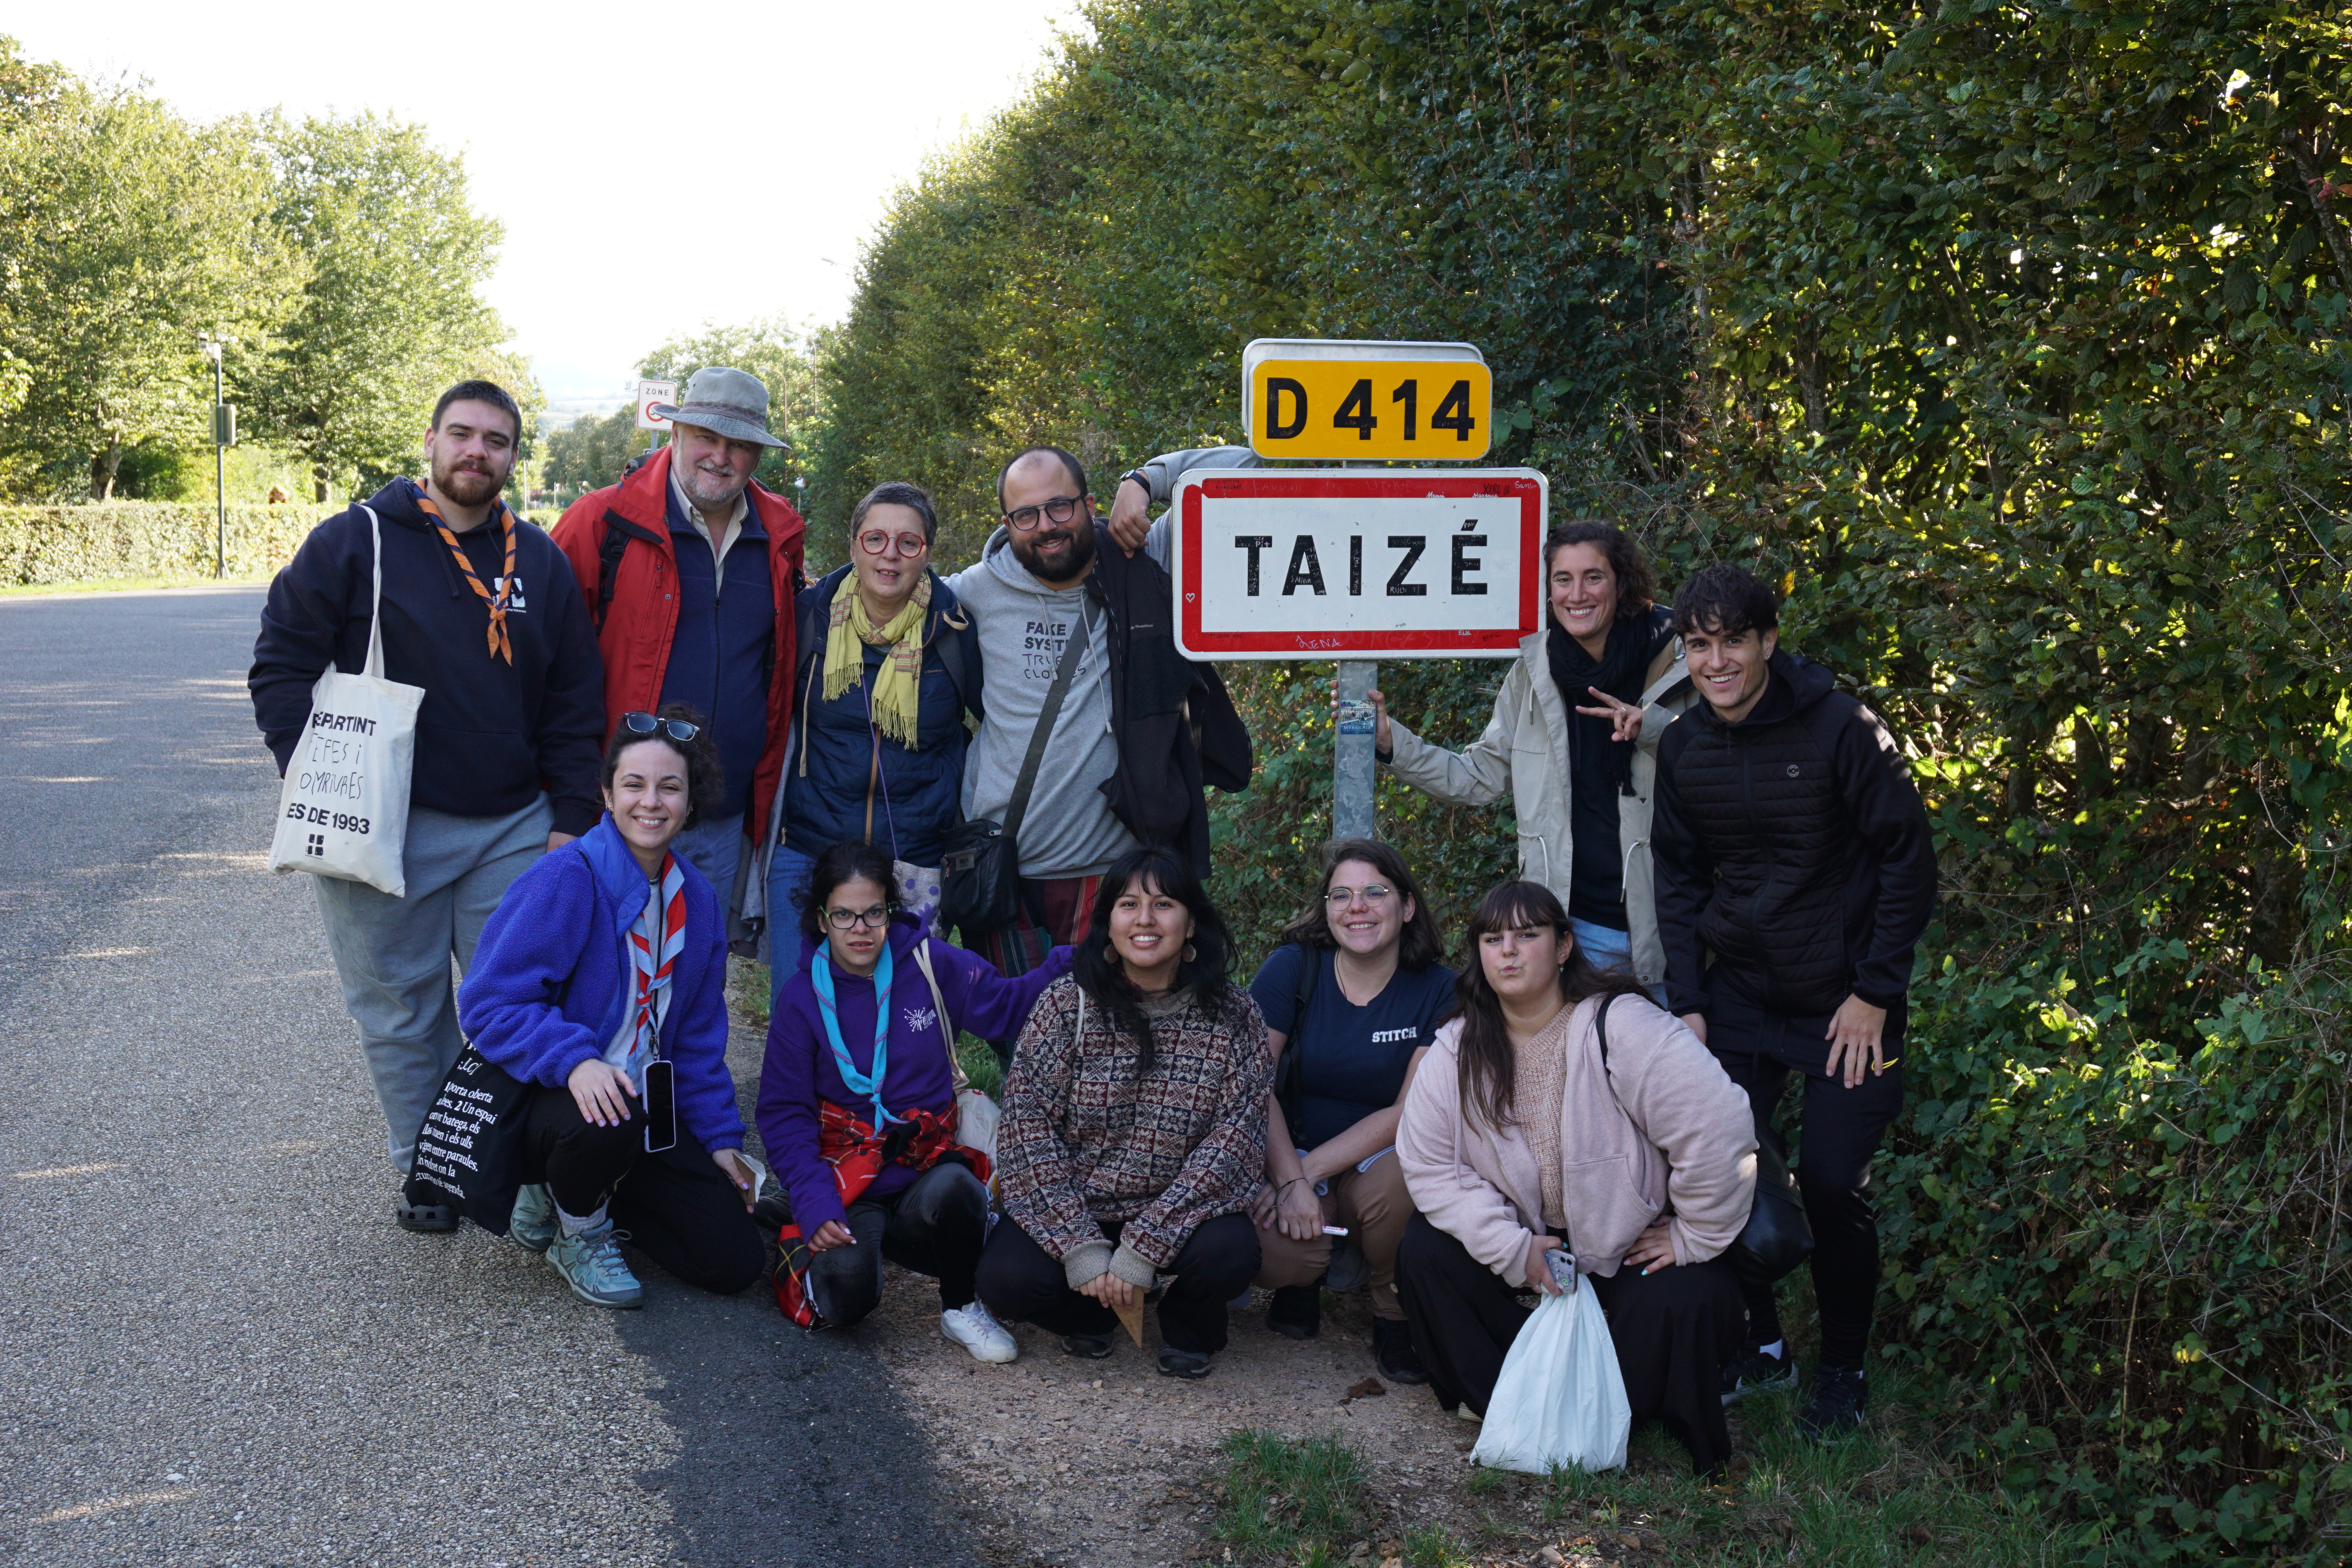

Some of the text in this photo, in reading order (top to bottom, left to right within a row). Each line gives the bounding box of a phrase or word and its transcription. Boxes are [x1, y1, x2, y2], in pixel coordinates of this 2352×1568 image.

[1267, 377, 1475, 441] D 414
[1235, 519, 1488, 596] TAIZÉ
[1026, 622, 1066, 635] FAKE
[1024, 637, 1089, 652] SYST
[287, 802, 370, 835] ES DE 1993
[1372, 1026, 1417, 1043] STITCH
[468, 1089, 493, 1103] oberta
[454, 1100, 463, 1111] 2
[462, 1102, 475, 1114] Un
[475, 1108, 498, 1125] espai
[443, 1112, 468, 1132] batega,
[469, 1122, 481, 1134] els
[445, 1131, 450, 1142] i
[449, 1132, 460, 1144] els
[460, 1135, 473, 1149] ulls
[432, 1145, 446, 1157] entre
[445, 1151, 478, 1171] paraules.
[439, 1165, 446, 1175] on
[448, 1164, 456, 1177] la
